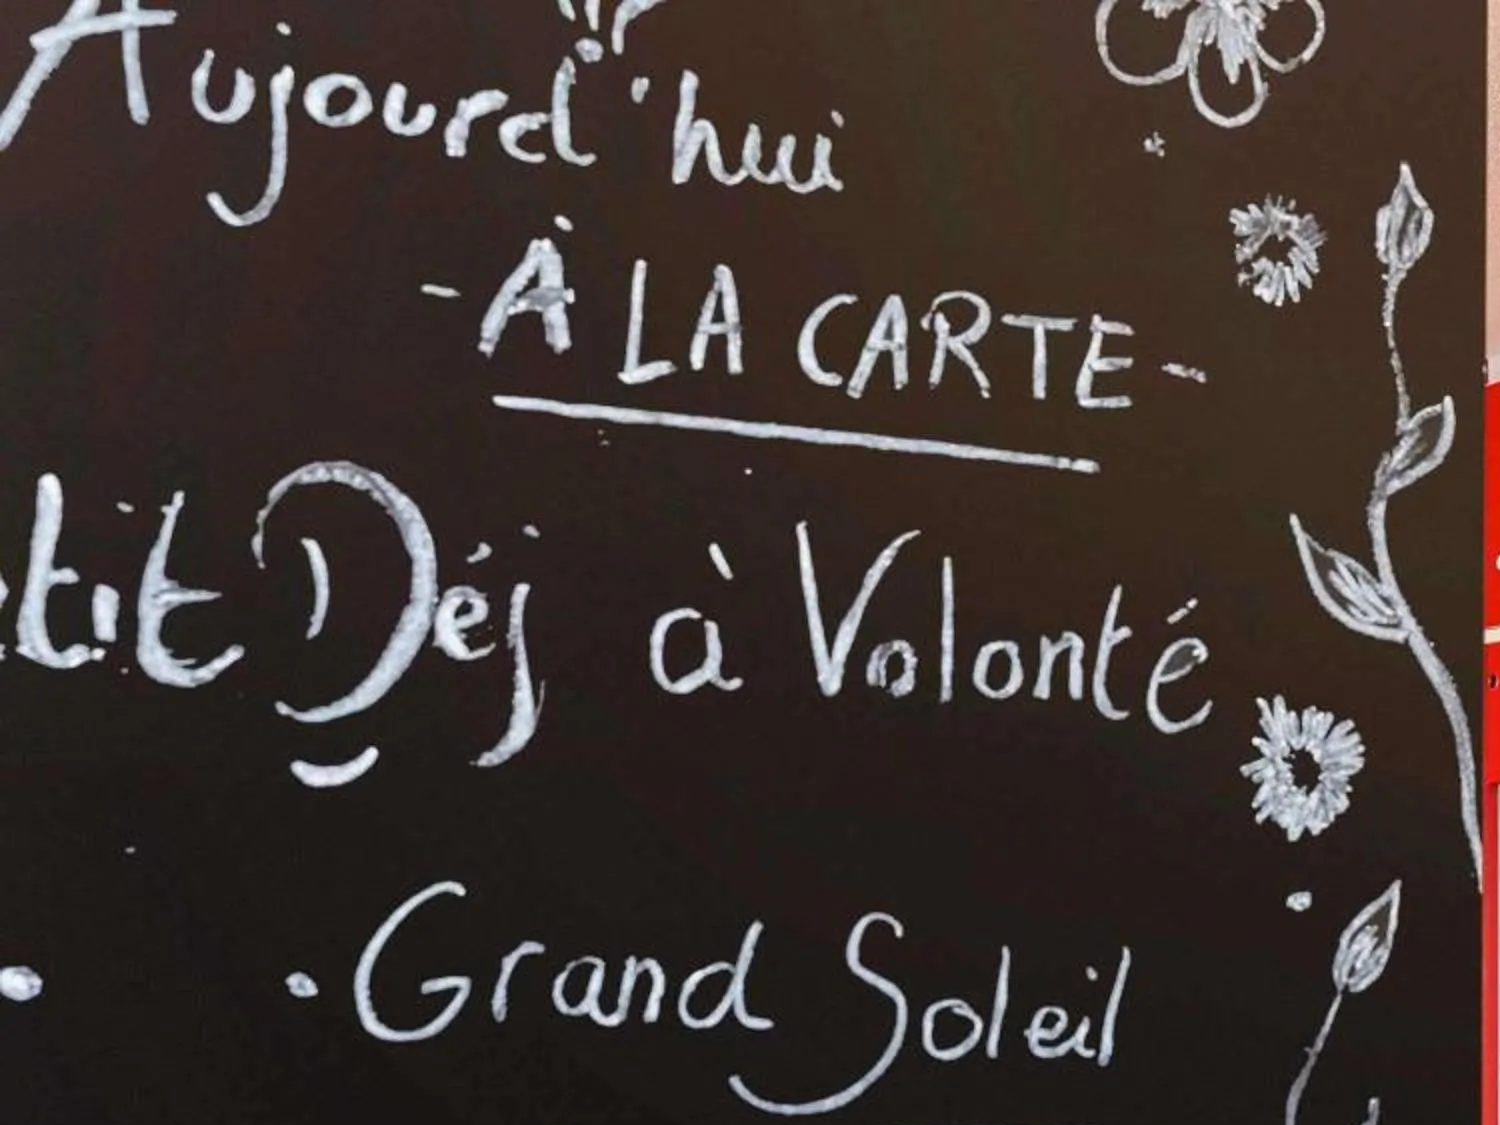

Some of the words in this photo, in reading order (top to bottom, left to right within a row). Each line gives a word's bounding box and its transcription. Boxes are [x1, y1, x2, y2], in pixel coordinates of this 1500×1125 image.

[617, 258, 744, 385] LA
[797, 290, 1135, 409] CARTE
[0, 472, 245, 688] tit
[251, 460, 545, 767] Déj
[649, 542, 744, 695] à
[795, 520, 1213, 735] Volonté
[353, 880, 774, 1042] Grand
[728, 911, 1131, 1116] Soleil
